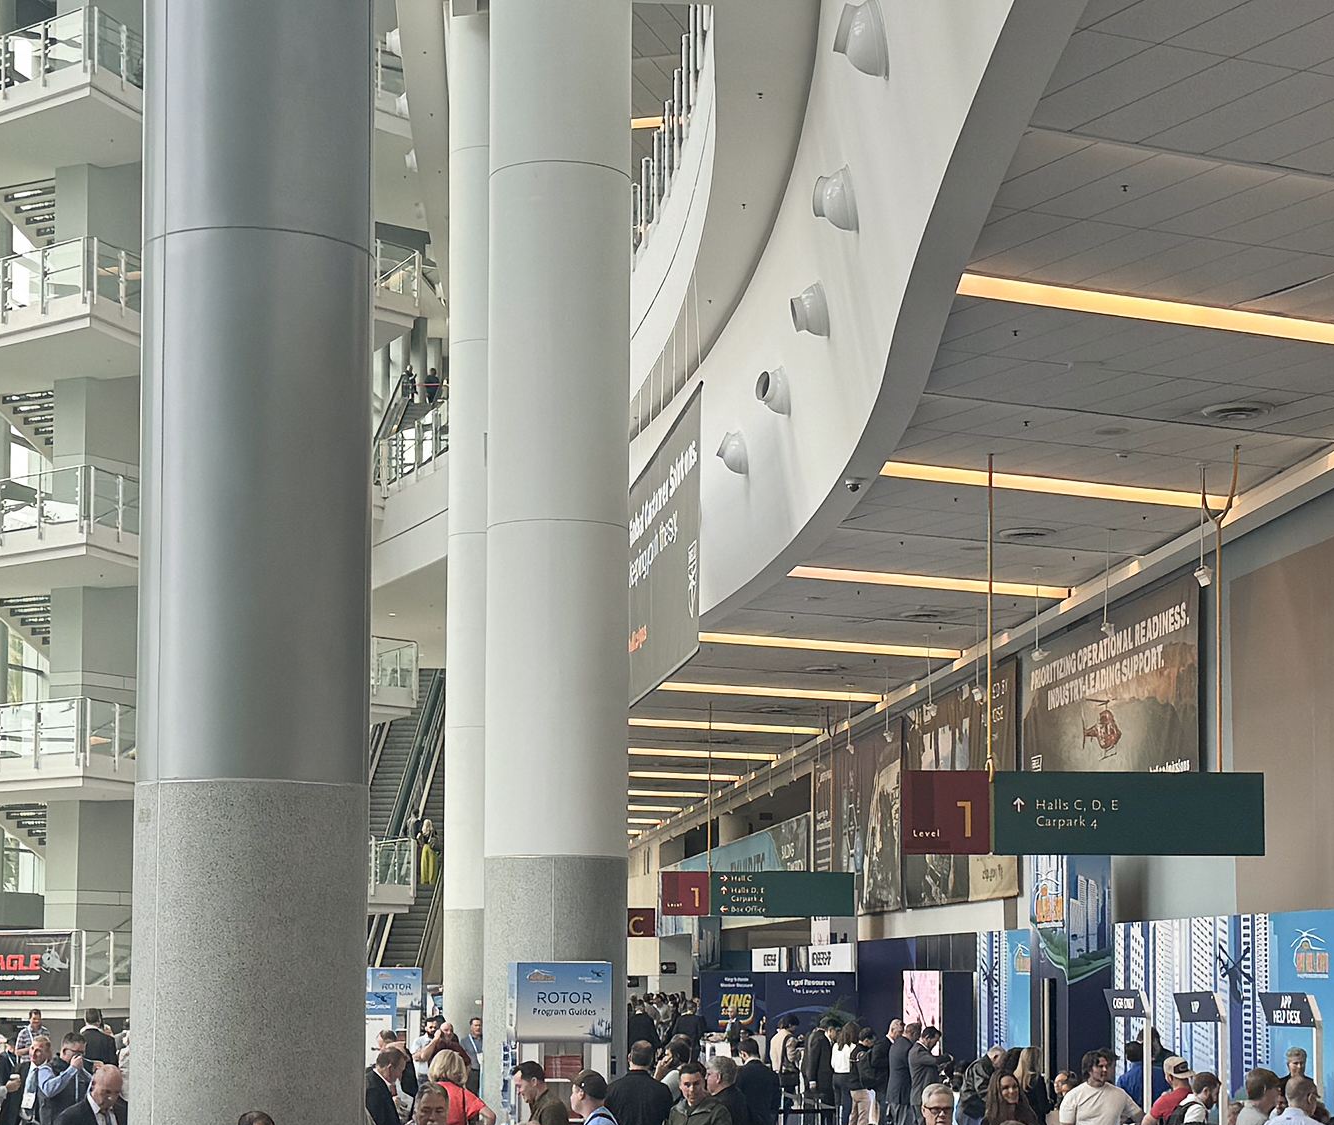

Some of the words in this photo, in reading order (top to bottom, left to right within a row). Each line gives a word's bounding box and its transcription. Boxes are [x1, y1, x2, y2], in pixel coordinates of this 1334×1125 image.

[1030, 651, 1077, 691] PRIORITIZING
[1077, 632, 1134, 671] OPERATIONAL
[1134, 601, 1190, 644] READINESS.
[1047, 660, 1121, 711] INDUSTRY-LEADING
[1121, 644, 1165, 682] SUPPORT.
[1035, 799, 1070, 812] Halls
[1073, 799, 1087, 813] C,
[1091, 799, 1106, 813] D,
[1111, 800, 1119, 812] E
[912, 829, 941, 838] Level
[956, 801, 972, 838] 1
[1035, 815, 1086, 830] Carpark
[1090, 819, 1098, 831] 4
[747, 874, 753, 882] C
[690, 887, 700, 908] 1
[730, 895, 758, 903] Carpark
[629, 917, 644, 936] C
[537, 992, 592, 1004] ROTOR
[721, 994, 752, 1008] KING
[1280, 995, 1292, 1009] APP
[533, 1008, 567, 1017] Program
[568, 1008, 597, 1016] Guides
[1286, 1010, 1301, 1024] DESK
